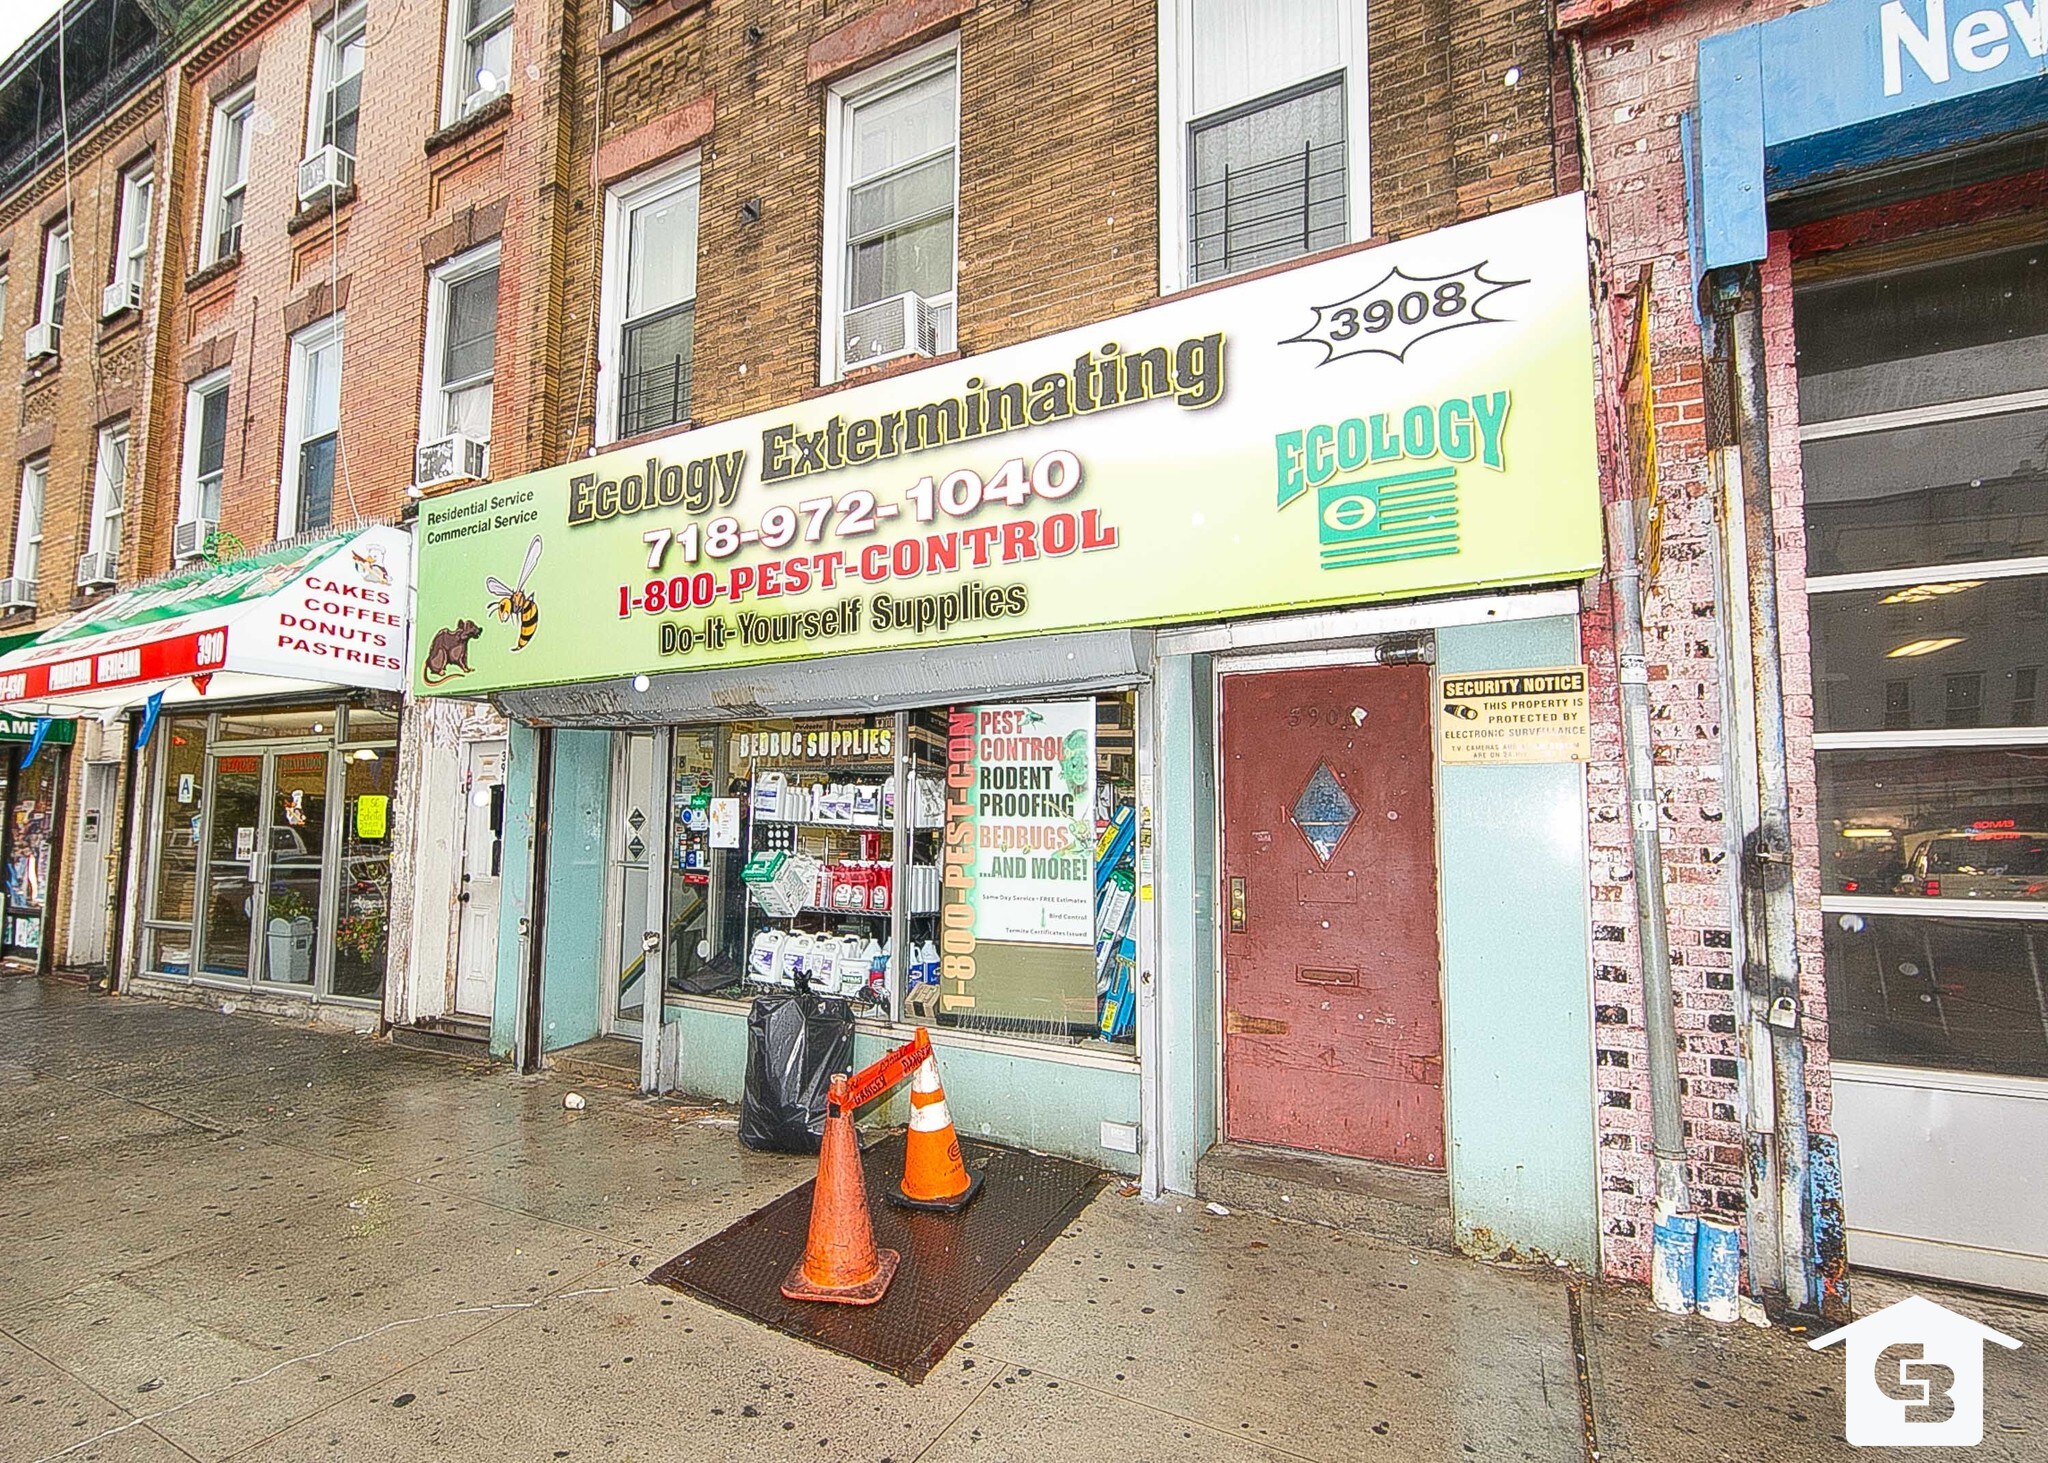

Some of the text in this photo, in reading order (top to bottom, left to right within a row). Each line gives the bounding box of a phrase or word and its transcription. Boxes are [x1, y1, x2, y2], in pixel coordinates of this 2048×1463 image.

[1329, 281, 1467, 342] 3908
[568, 332, 1227, 526] Ecology Exterminating
[1275, 388, 1512, 511] ECOLOGY
[427, 489, 534, 526] Residential Service
[642, 449, 1082, 570] 718-972-1040
[427, 510, 538, 545] Commercial Service
[617, 508, 1119, 618] 1-800-PEST-CONTROL
[305, 576, 390, 605] CAKES
[304, 598, 400, 627] COFFEE
[659, 582, 1028, 656] Do-It-Yourself Supplies
[280, 613, 387, 647] DONUTS
[196, 630, 225, 666] 3910
[278, 635, 401, 670] PASTRIES
[1445, 674, 1582, 697] SECURITY NOTICE
[1484, 697, 1583, 711] THIS PROPERTY IS
[1488, 712, 1577, 724] PROTECTED BY
[979, 709, 1026, 735] PEST
[1445, 729, 1505, 739] ELECTRONIC
[807, 728, 891, 757] SUPPLIES
[979, 736, 1067, 762] CONTROL
[181, 778, 190, 795] A
[979, 766, 1053, 790] RODENT
[979, 792, 1074, 817] PROOFING
[979, 825, 1069, 850] BEDBUGS
[942, 706, 978, 1012] 1-800-PEST-CON
[1031, 857, 1088, 881] MORE!
